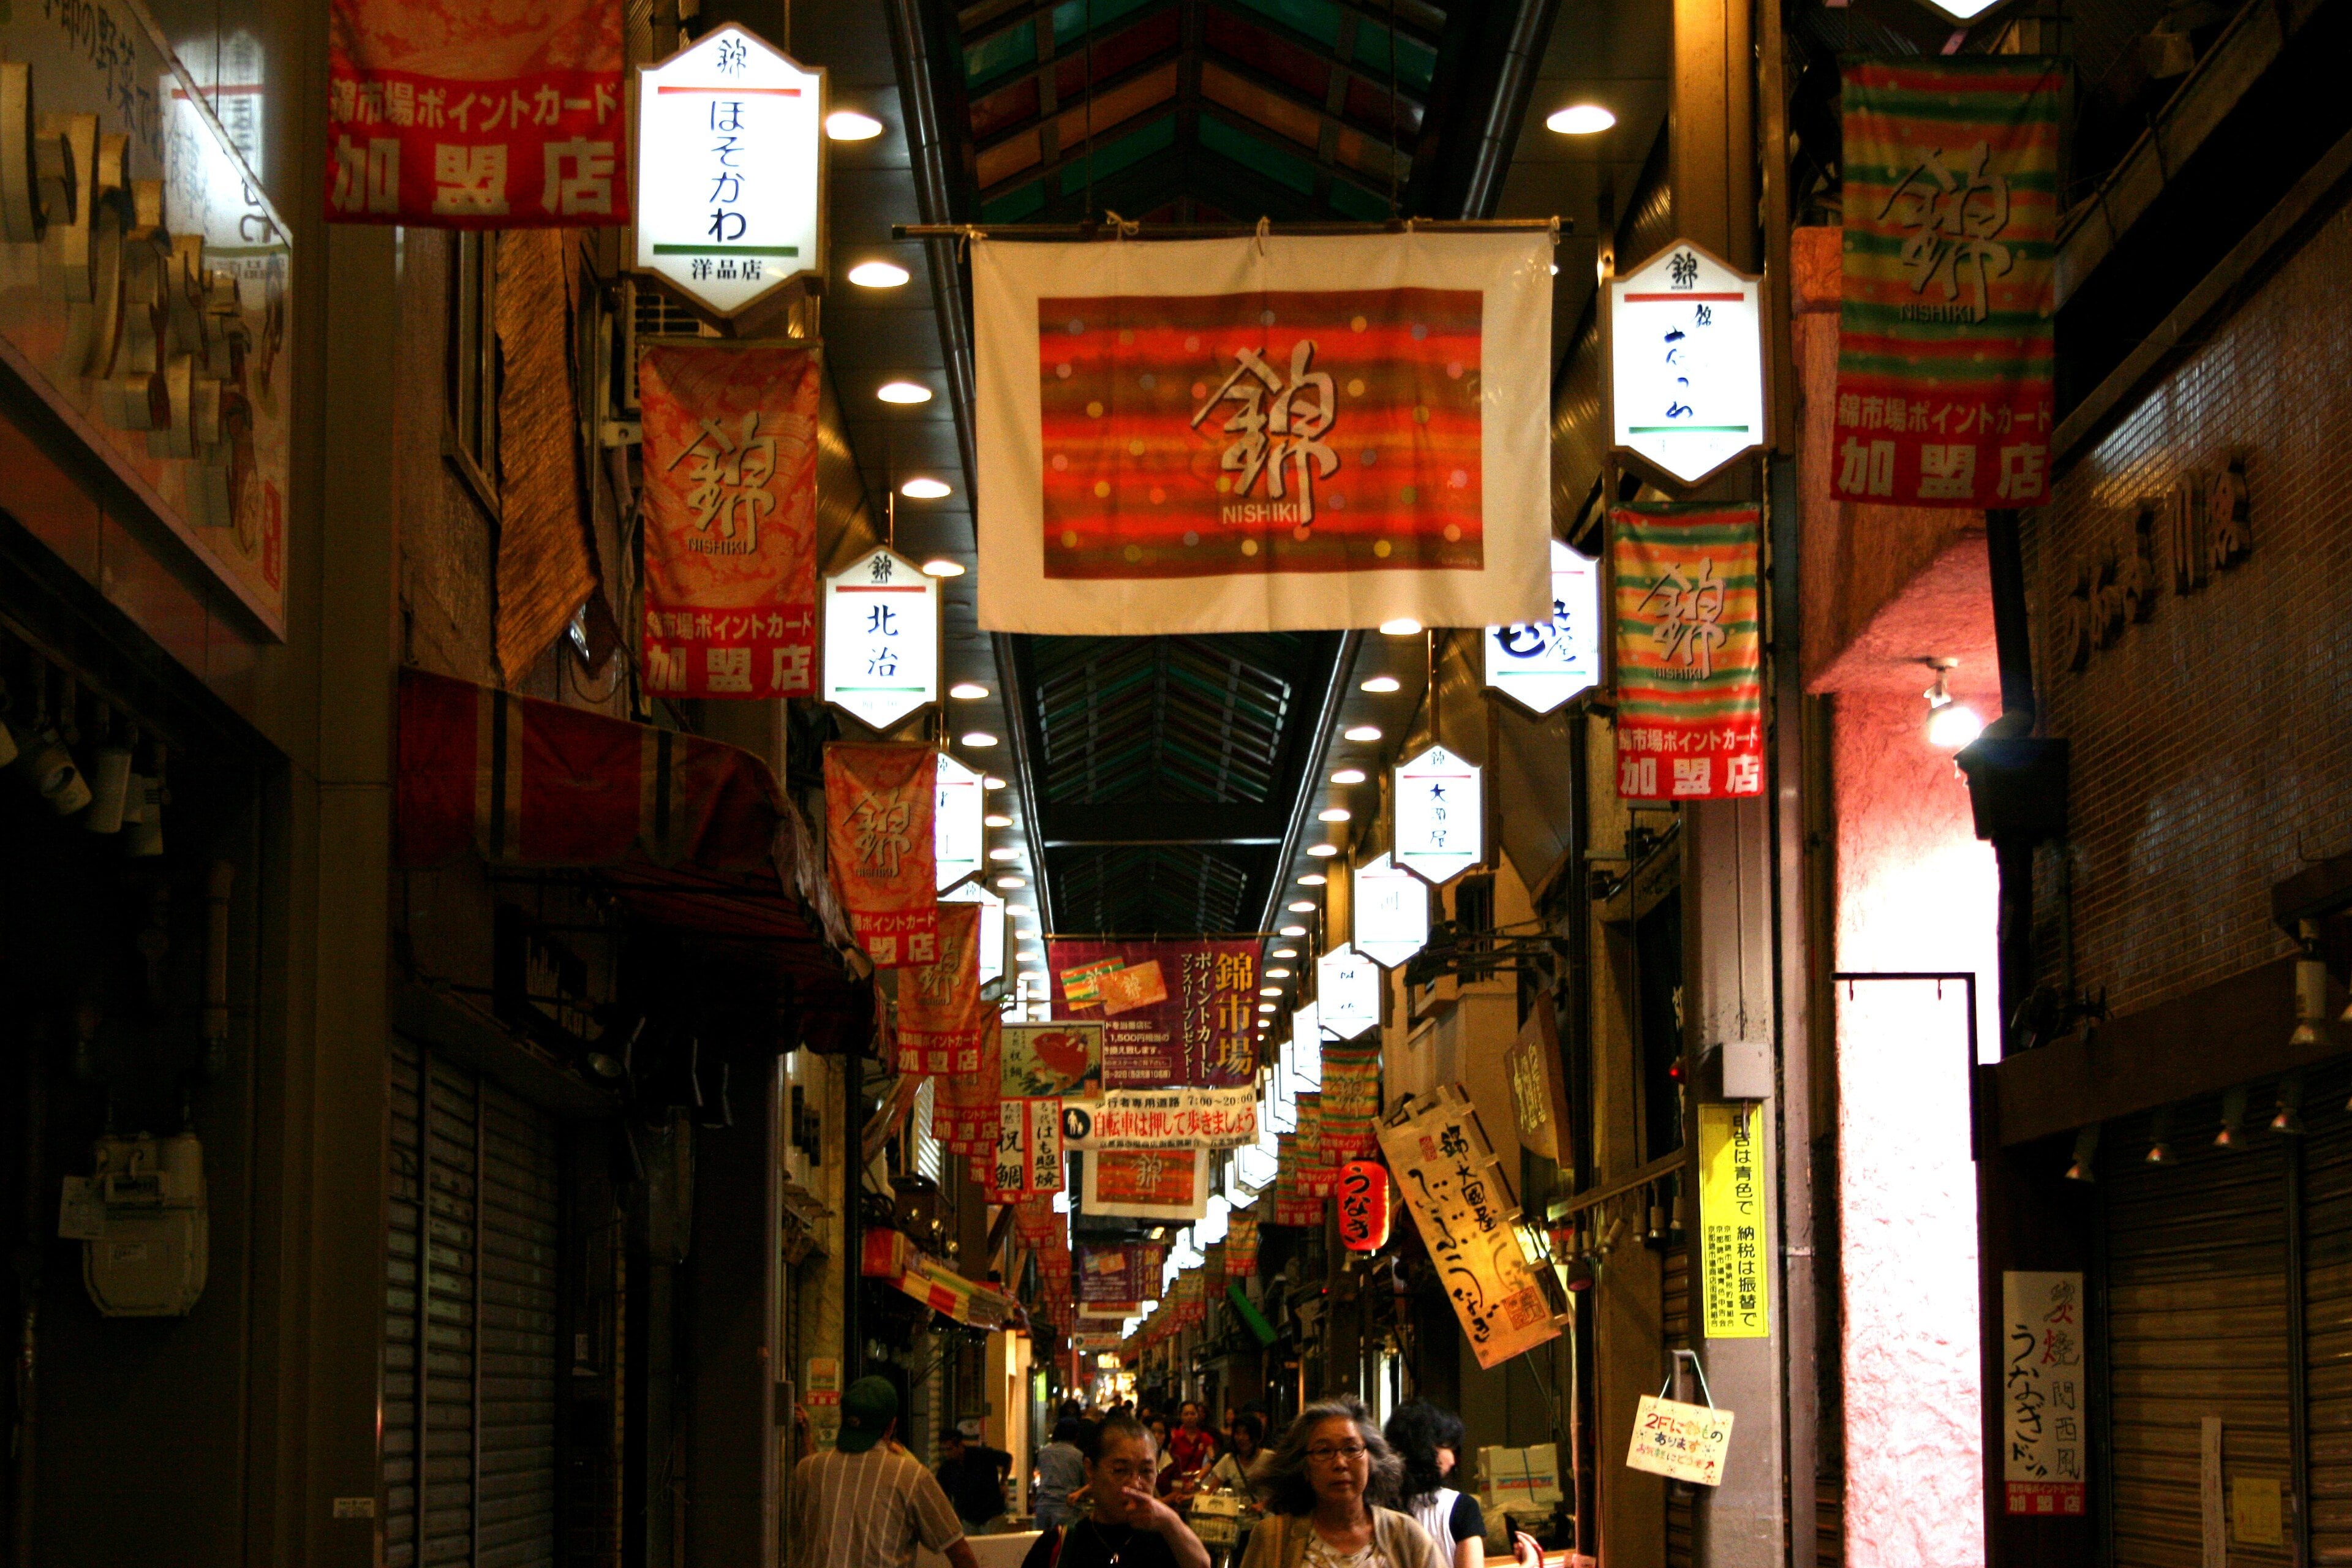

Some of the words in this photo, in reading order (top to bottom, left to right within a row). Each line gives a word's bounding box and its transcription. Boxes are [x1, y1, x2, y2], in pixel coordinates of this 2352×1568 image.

[331, 78, 616, 132] 錦市場ポイントカード
[331, 134, 614, 216] 加盟店
[709, 101, 746, 243] ほそかわ
[1879, 141, 2012, 323] 錦
[692, 260, 761, 281] 洋品店
[1666, 252, 1698, 288] 錦
[1901, 304, 1974, 323] NISHIKI
[1191, 339, 1341, 527] 錦
[1838, 393, 2051, 434] 錦市場ポイントカード
[667, 410, 778, 556] 錦
[1838, 436, 2046, 499] 加盟店
[1223, 503, 1297, 524] NISHIKI
[687, 538, 748, 555] NISHIKI
[868, 554, 892, 584] 錦
[867, 605, 899, 677] 北治
[1638, 557, 1726, 681] 錦
[647, 645, 812, 693] 加盟店
[1655, 667, 1703, 680] NISHIKI
[1619, 727, 1759, 753] 錦市場ポイントカード
[1621, 754, 1759, 796] 加盟店
[843, 788, 911, 878] 錦
[869, 933, 935, 963] 盟店
[1194, 952, 1213, 1079] ポイントカード
[1214, 952, 1253, 1077] 錦市場
[899, 1050, 978, 1072] 加盟店
[1094, 1107, 1255, 1138] 自転車は押して歩きましょう
[1344, 1166, 1372, 1243] うなぎ
[1716, 1225, 1725, 1328] 京都錦市場青色申告会
[1737, 1226, 1757, 1327] 納税は振替で
[1654, 1431, 1701, 1453] あります
[2010, 1494, 2080, 1512] 加盟店
